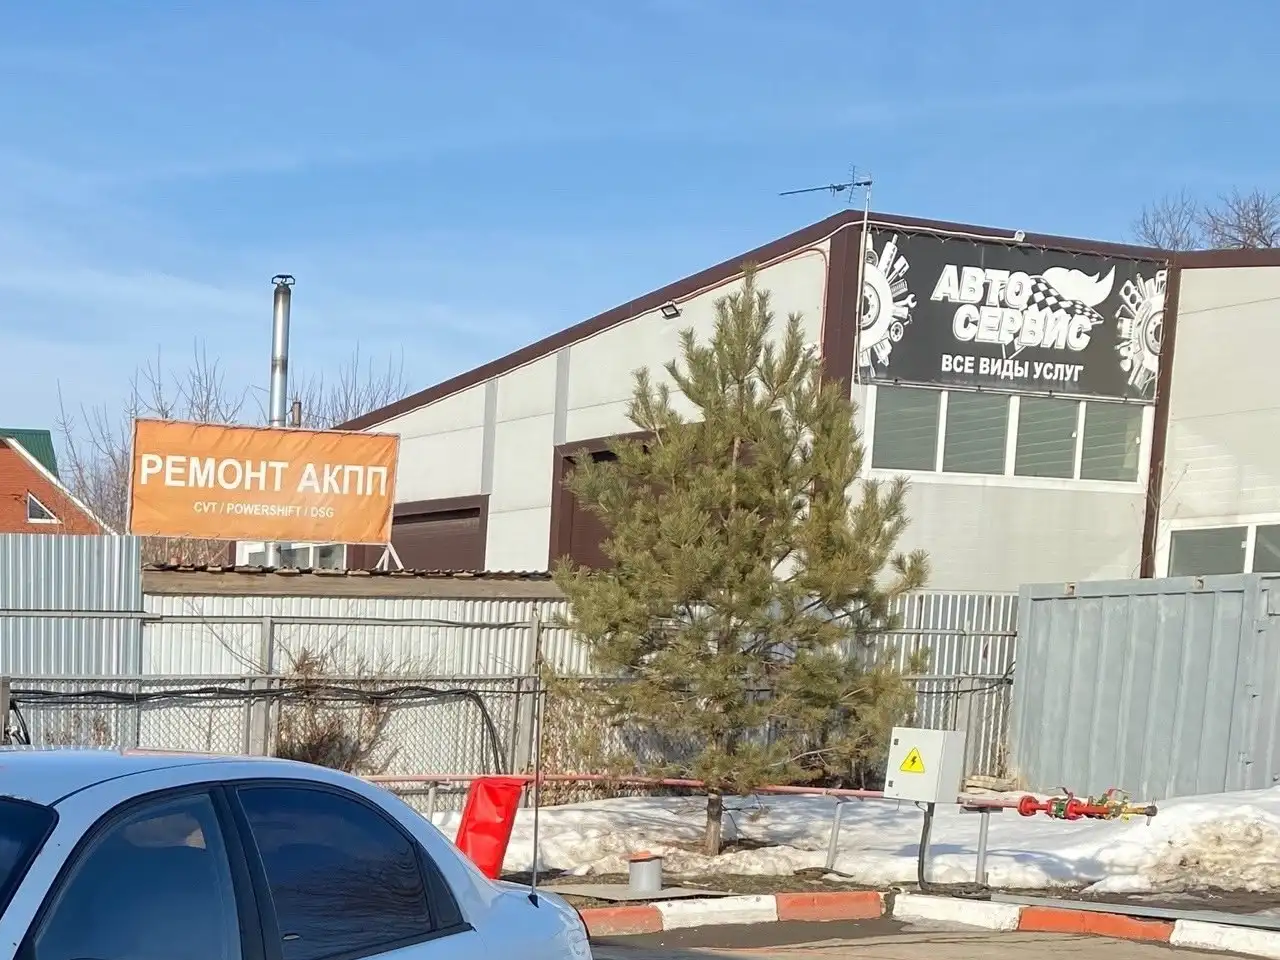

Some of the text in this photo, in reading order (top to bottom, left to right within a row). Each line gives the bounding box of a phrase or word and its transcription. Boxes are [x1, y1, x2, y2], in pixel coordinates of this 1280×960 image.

[929, 263, 1033, 309] АВТО
[952, 303, 1093, 351] СЕРВИС
[941, 354, 1084, 382] ВСЕ ВИДЫ УСЛУГ
[140, 453, 388, 497] РЕМОНТ АКПП
[193, 501, 218, 514] CVT
[227, 502, 302, 517] POWERSHIFT
[310, 505, 334, 519] DSG
